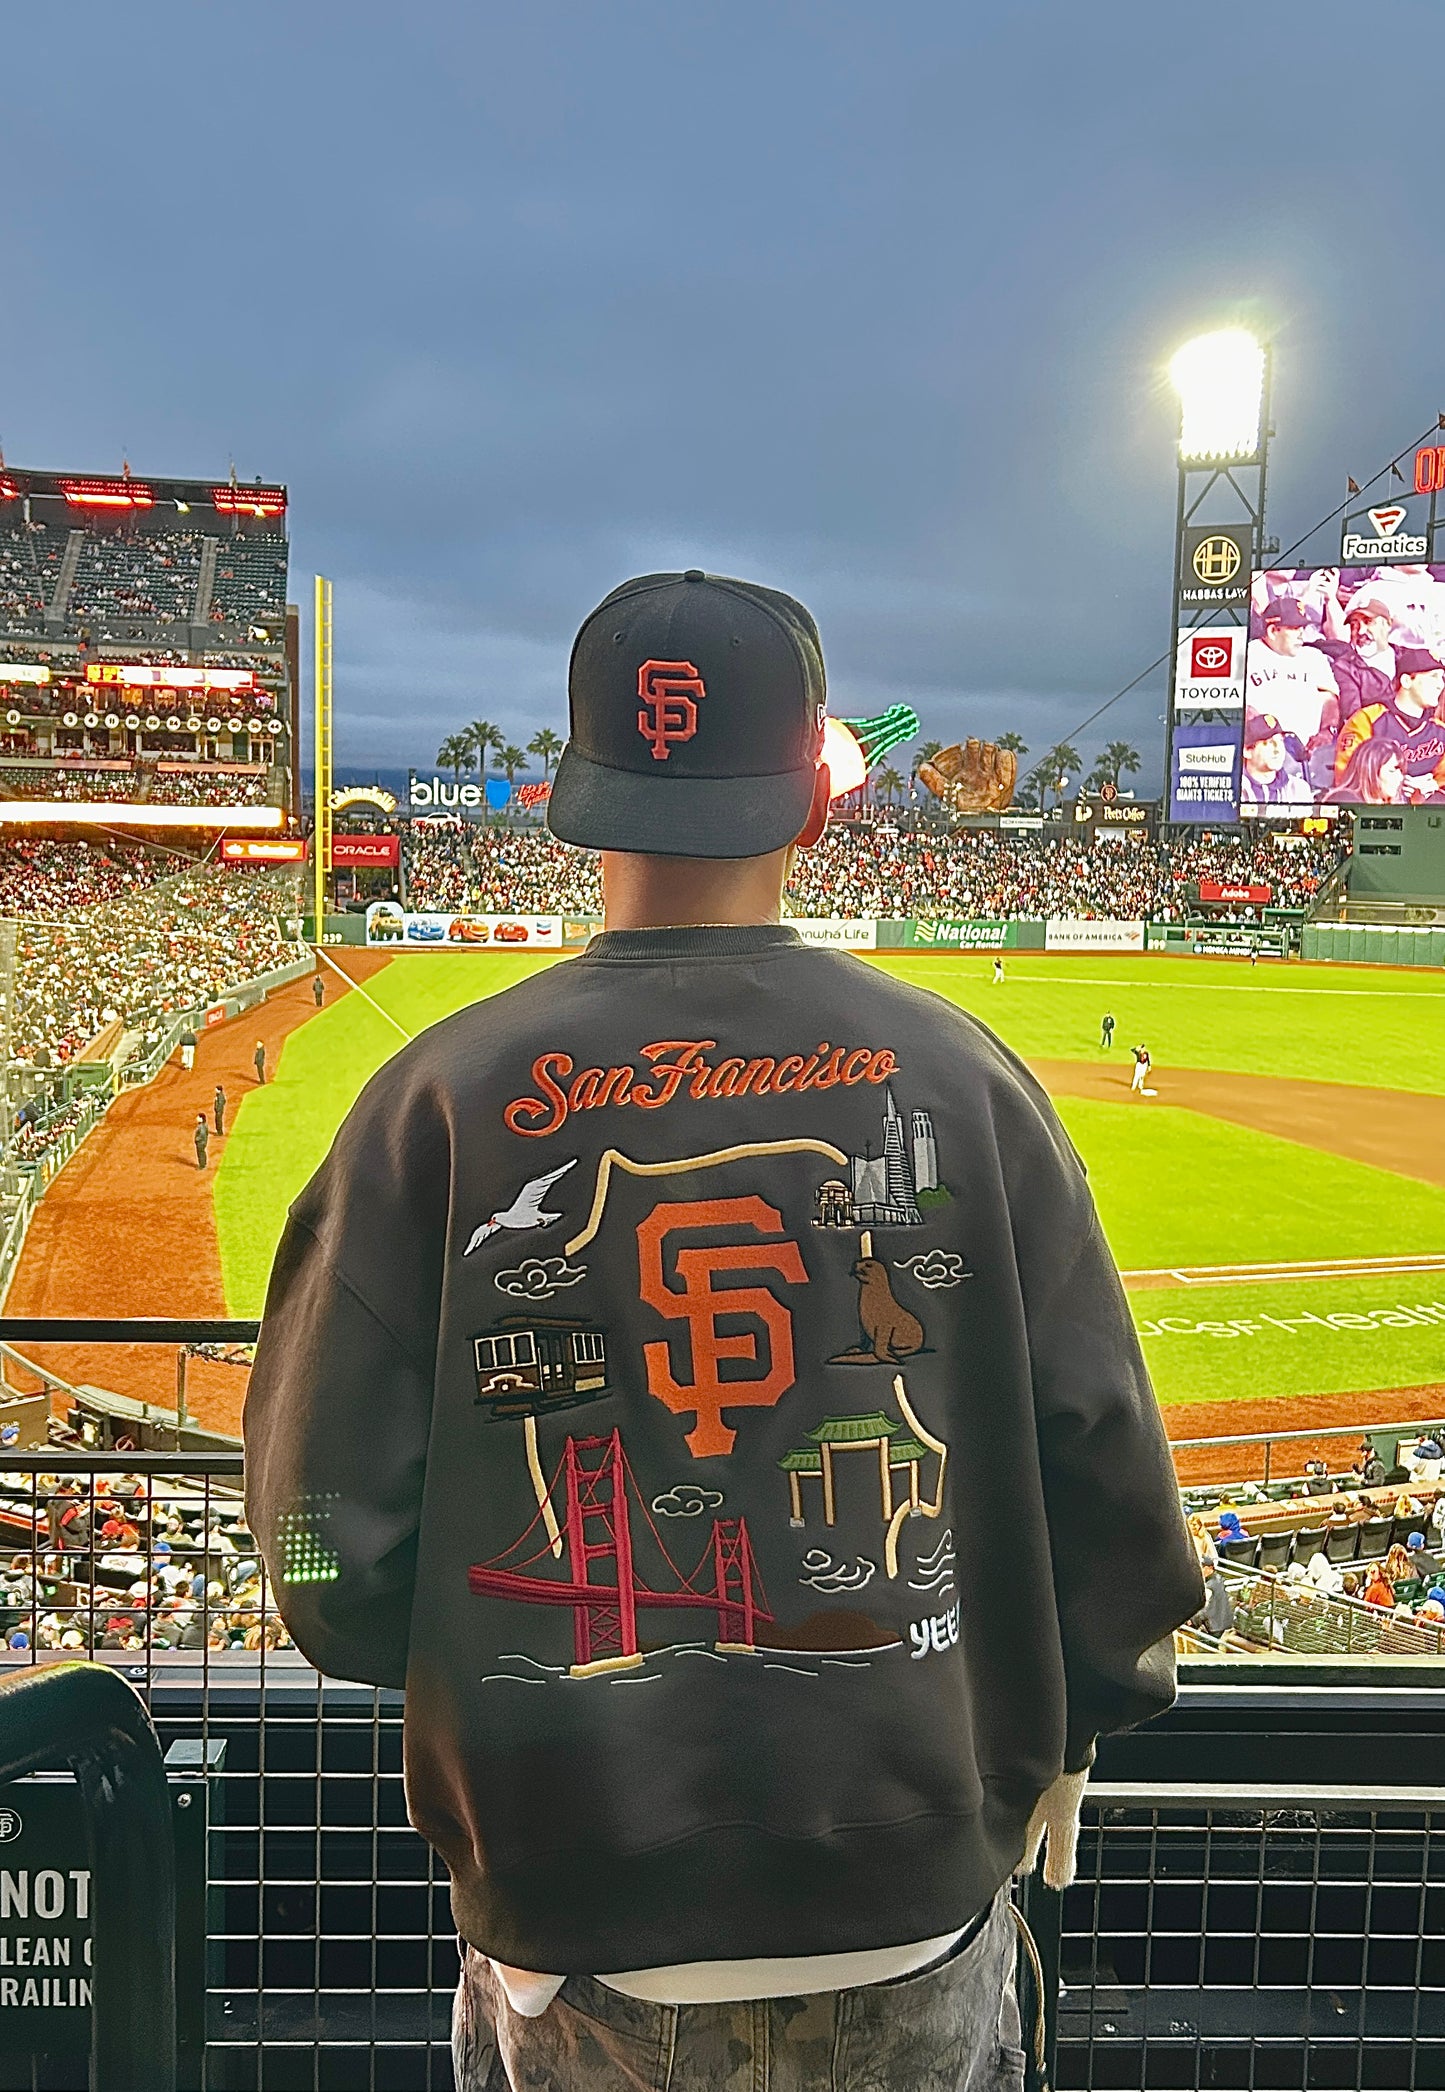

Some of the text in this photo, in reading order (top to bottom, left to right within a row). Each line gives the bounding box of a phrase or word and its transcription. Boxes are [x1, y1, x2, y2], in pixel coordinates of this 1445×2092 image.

[1346, 537, 1425, 555] Fanatics
[1183, 587, 1248, 600] HABBAS LAW
[1180, 687, 1240, 699] TOYOTA
[637, 659, 706, 760] SF
[1185, 753, 1227, 764] StubHub
[1180, 775, 1232, 789] 100% VERIFIED
[410, 776, 482, 807] blue
[1176, 788, 1234, 802] GIANTS TICKETS
[1122, 806, 1146, 822] Coffee
[333, 844, 391, 857] ORACLE
[1220, 887, 1250, 899] Adobe
[321, 932, 343, 944] 339
[844, 928, 869, 940] Life
[936, 923, 1007, 941] National
[1048, 933, 1122, 941] BANK OF AMERICA
[504, 1040, 901, 1137] San Francisco
[636, 1195, 810, 1458] SF
[0, 1869, 91, 1920] NOT
[0, 1937, 70, 1967] LEAN
